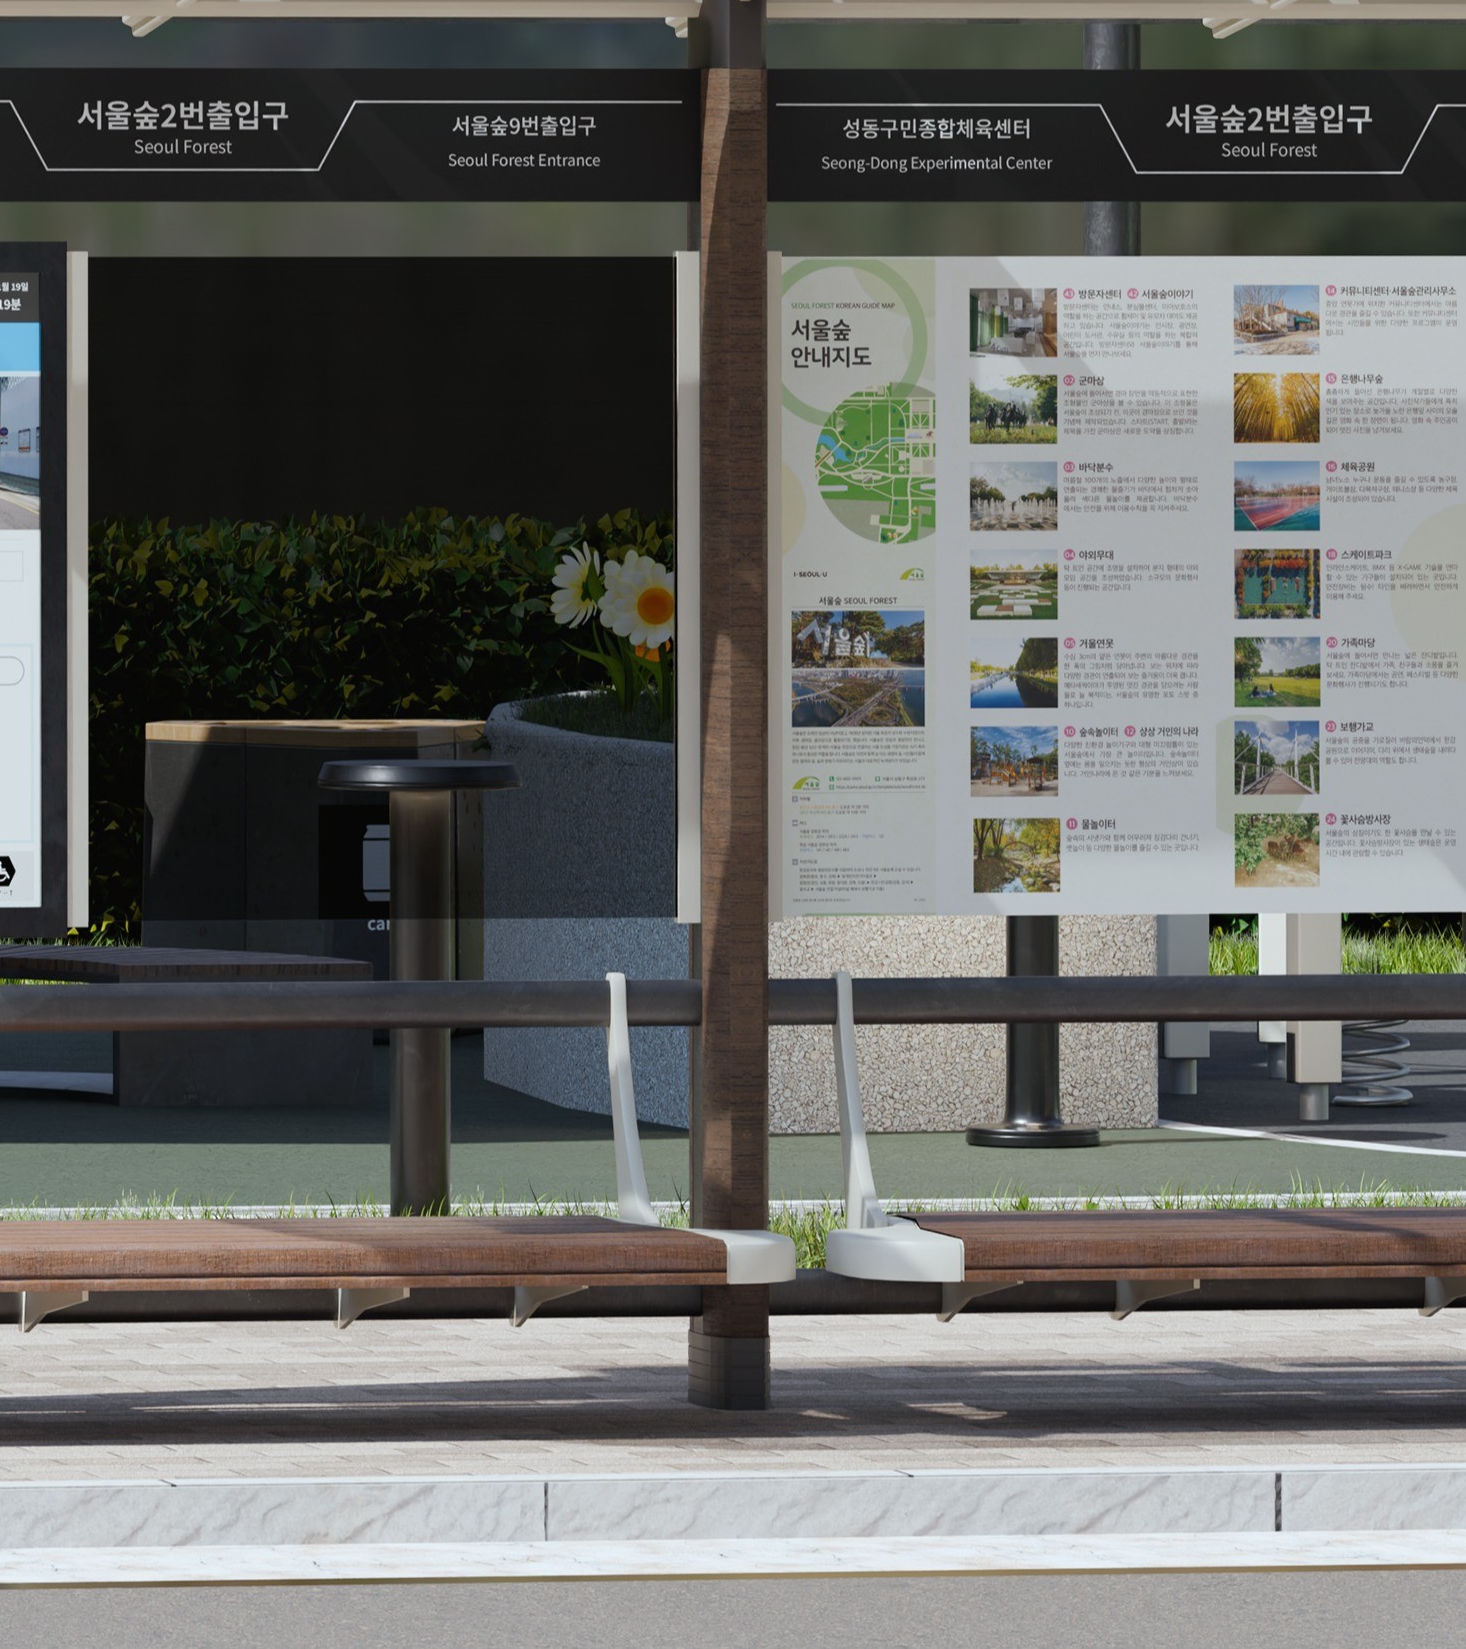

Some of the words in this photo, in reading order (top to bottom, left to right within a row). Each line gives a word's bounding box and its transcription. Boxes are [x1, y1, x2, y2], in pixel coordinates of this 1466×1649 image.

[78, 101, 288, 130] 서울숲2번출입구
[1166, 104, 1372, 134] 서울숲2번출입구
[453, 116, 596, 136] 서울숲9번출입구
[843, 119, 1029, 139] 성동구민종합체육센터
[135, 139, 178, 154] Seoul
[184, 140, 232, 154] Forest
[1222, 142, 1265, 157] Seoul
[1271, 143, 1317, 157] Forest
[449, 153, 487, 166] Seoul
[493, 154, 534, 166] Forest
[539, 154, 600, 166] Entrance
[822, 157, 907, 173] Seong-Dong
[912, 156, 1002, 172] Experimental
[1006, 157, 1052, 169] Center
[11, 281, 29, 292] 19일
[1078, 289, 1122, 300] 방문자센터
[1141, 289, 1194, 300] 서울숲이야기
[790, 302, 810, 310] SEOUL
[792, 319, 851, 341] 서울숲
[791, 347, 871, 368] 안내지도
[1078, 375, 1106, 387] 군마상
[1341, 373, 1384, 385] 은행나무숲
[1078, 462, 1114, 473] 바닥분수
[1340, 461, 1375, 473] 체육공원
[1078, 550, 1114, 561] 야외무대
[1341, 549, 1392, 560] 스케이트파크
[818, 596, 842, 606] 서울숲
[843, 597, 868, 605] SEOUL
[869, 597, 898, 605] FOREST
[1079, 638, 1114, 649] 거울연못
[1341, 637, 1376, 648] 가족마당
[1079, 726, 1119, 738] 숲속놀이터
[1139, 726, 1156, 738] 상상
[1157, 726, 1182, 737] 거인의
[1182, 726, 1199, 737] 나라
[1340, 721, 1374, 733] 보행가교
[1081, 818, 1116, 831] 물놀이터
[1340, 814, 1391, 826] 꽃사슴방사장
